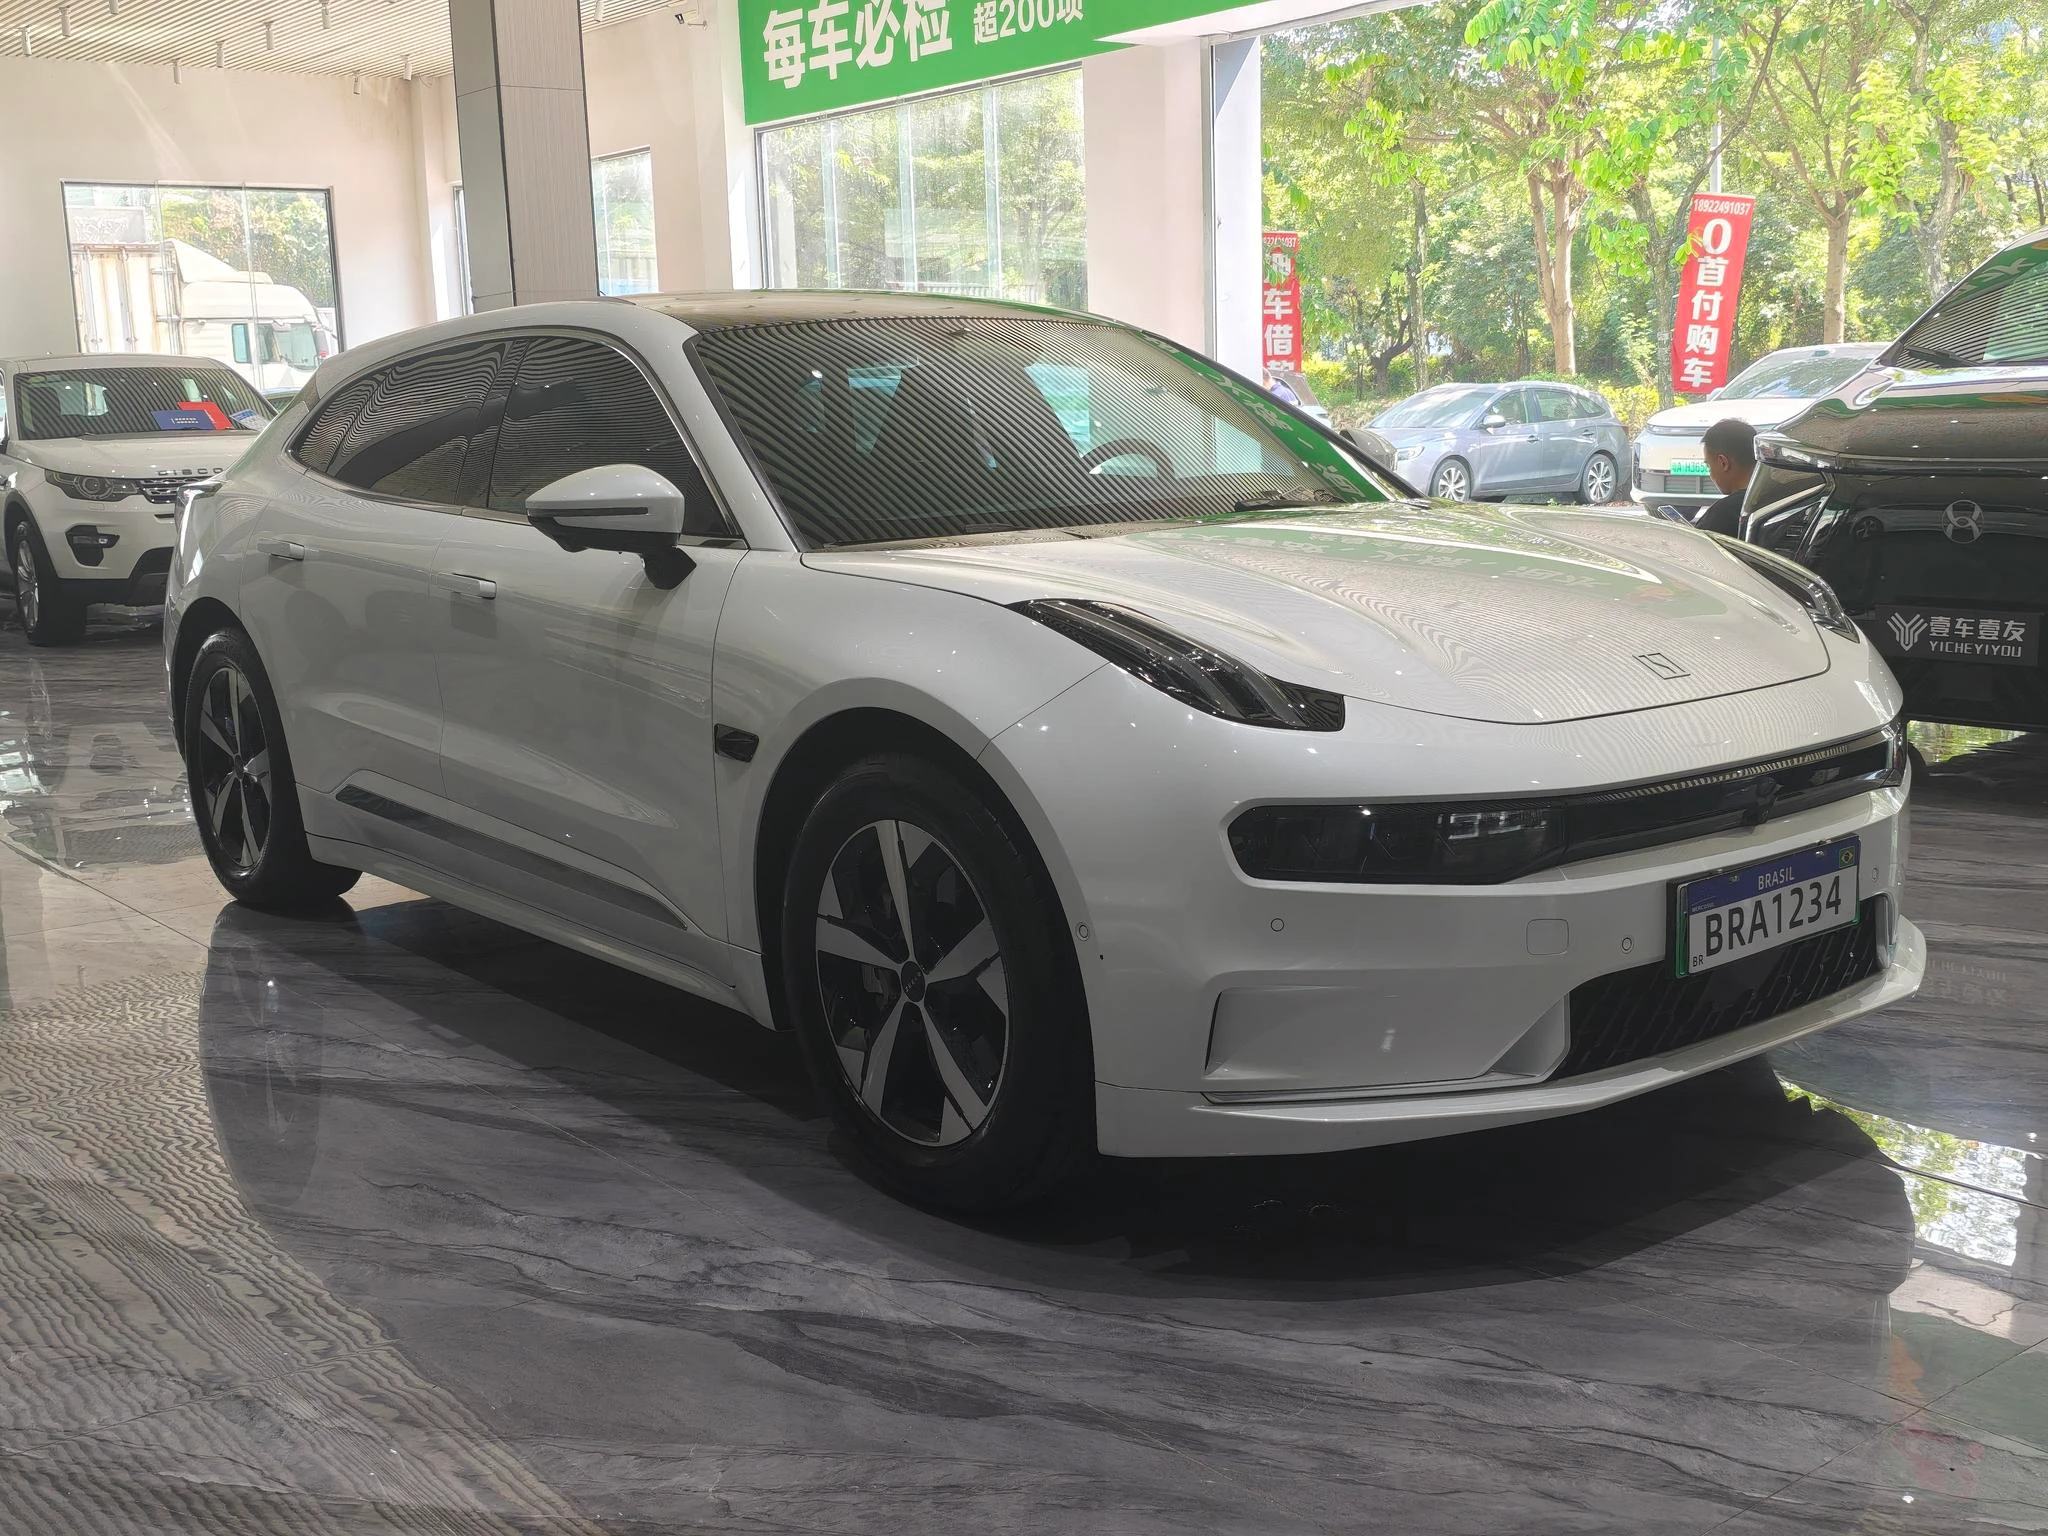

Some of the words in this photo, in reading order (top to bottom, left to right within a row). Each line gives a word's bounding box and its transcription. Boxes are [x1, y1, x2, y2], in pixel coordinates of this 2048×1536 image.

[763, 0, 953, 89] 每车必检
[973, 0, 1084, 45] 超200项
[1693, 198, 1751, 216] 18922491037
[1929, 616, 2027, 642] 壹车壹友
[1929, 640, 2022, 657] YICHEYIYOU
[1758, 866, 1795, 891] BRASIL
[1705, 875, 1842, 958] BRA1234
[1692, 955, 1704, 967] BR
